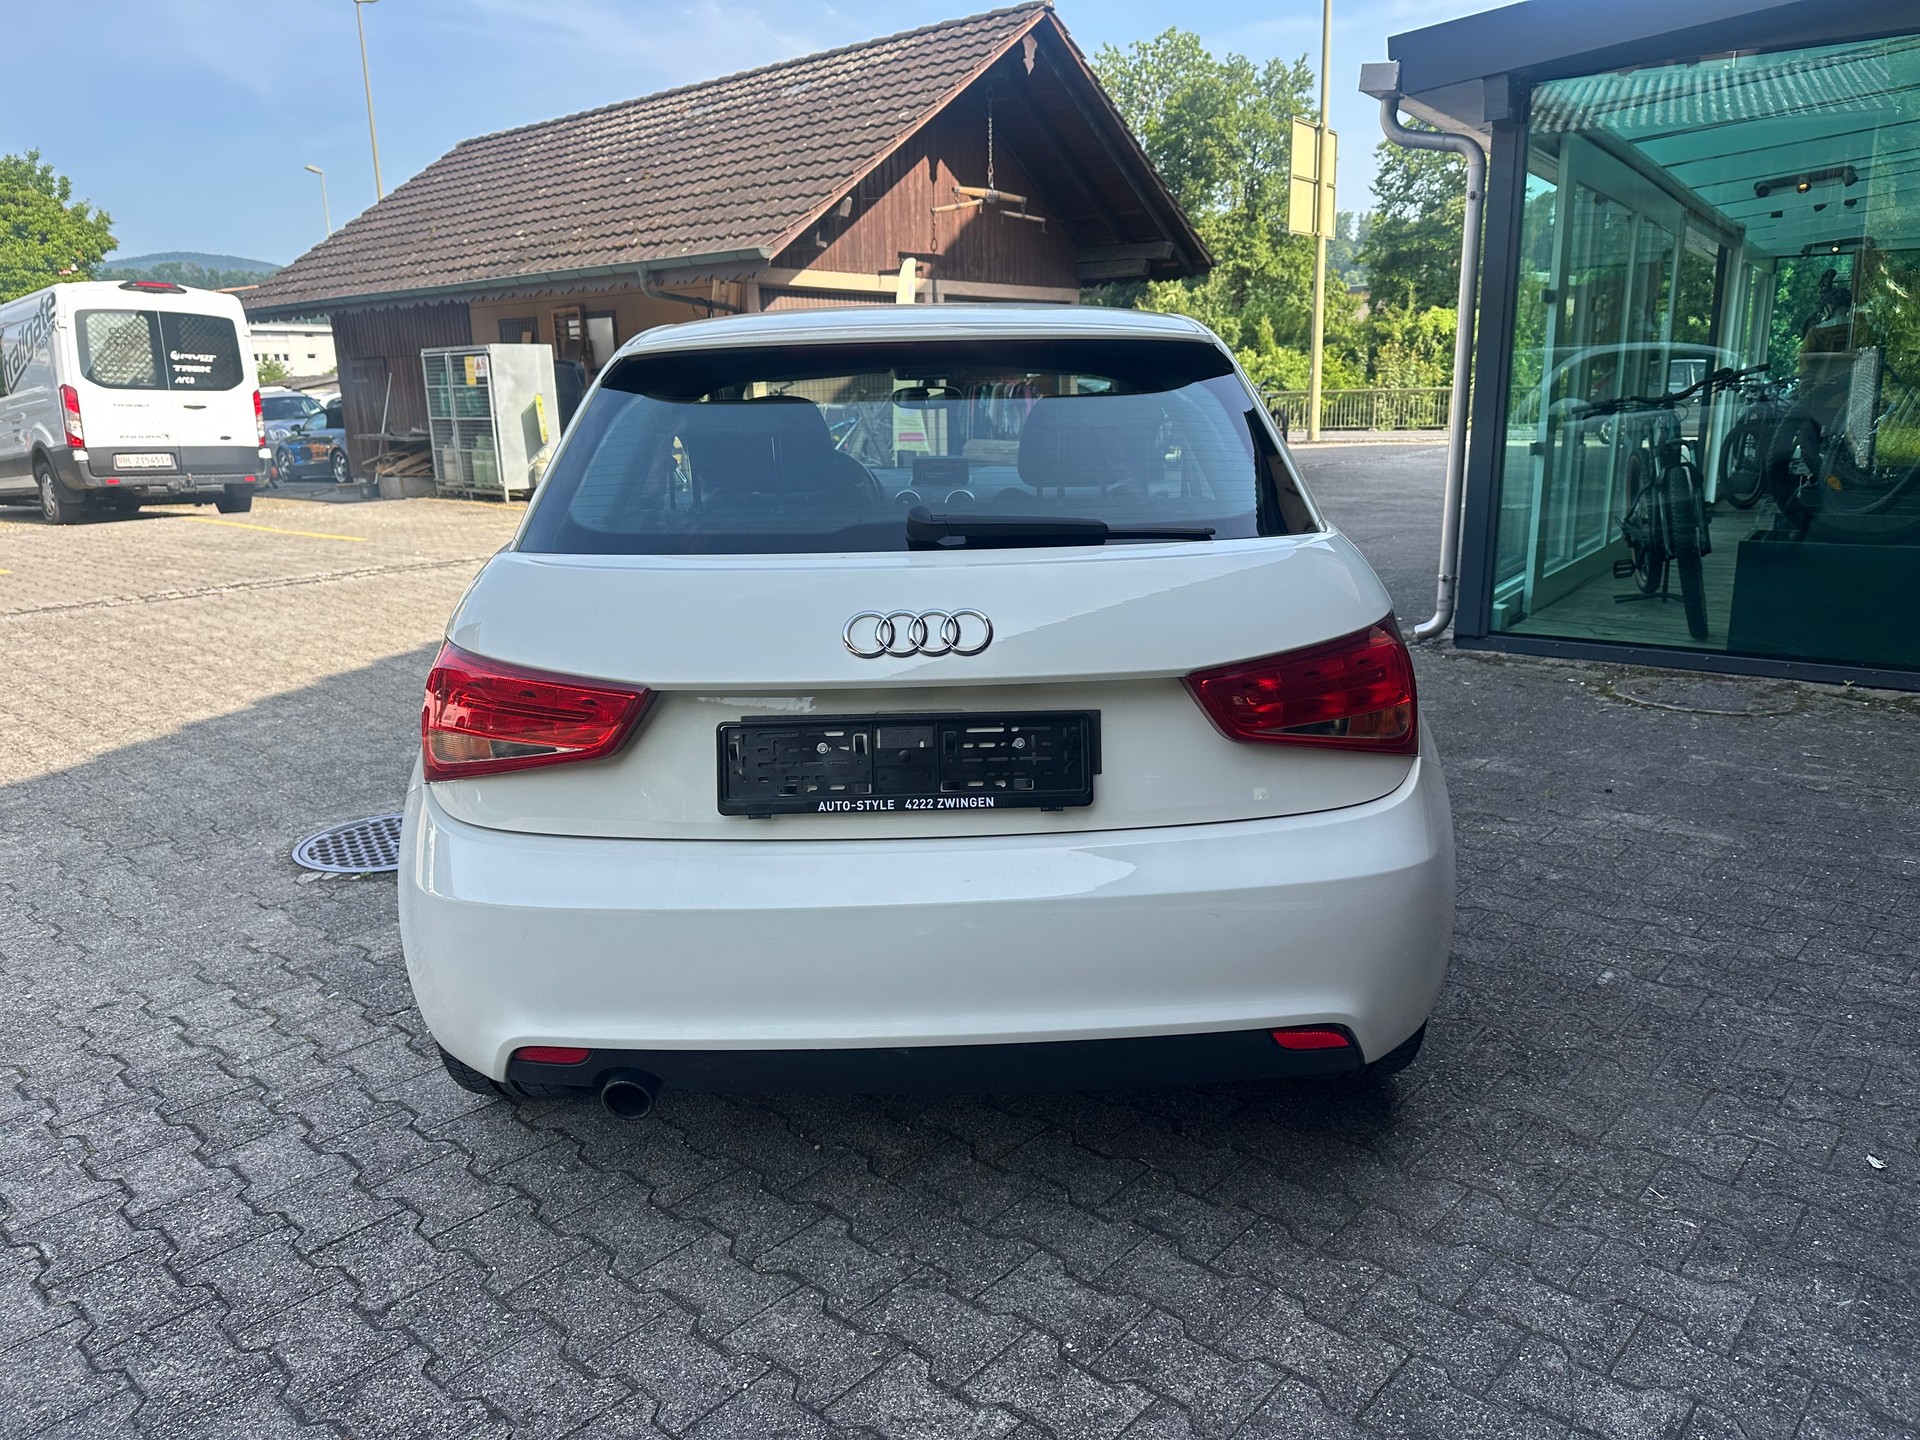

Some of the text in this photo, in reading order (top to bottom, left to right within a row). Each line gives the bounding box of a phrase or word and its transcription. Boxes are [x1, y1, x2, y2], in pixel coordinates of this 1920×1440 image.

[3, 292, 56, 394] trailgate
[817, 796, 995, 812] AUTO-STYLE 4222 ZWINGEN
